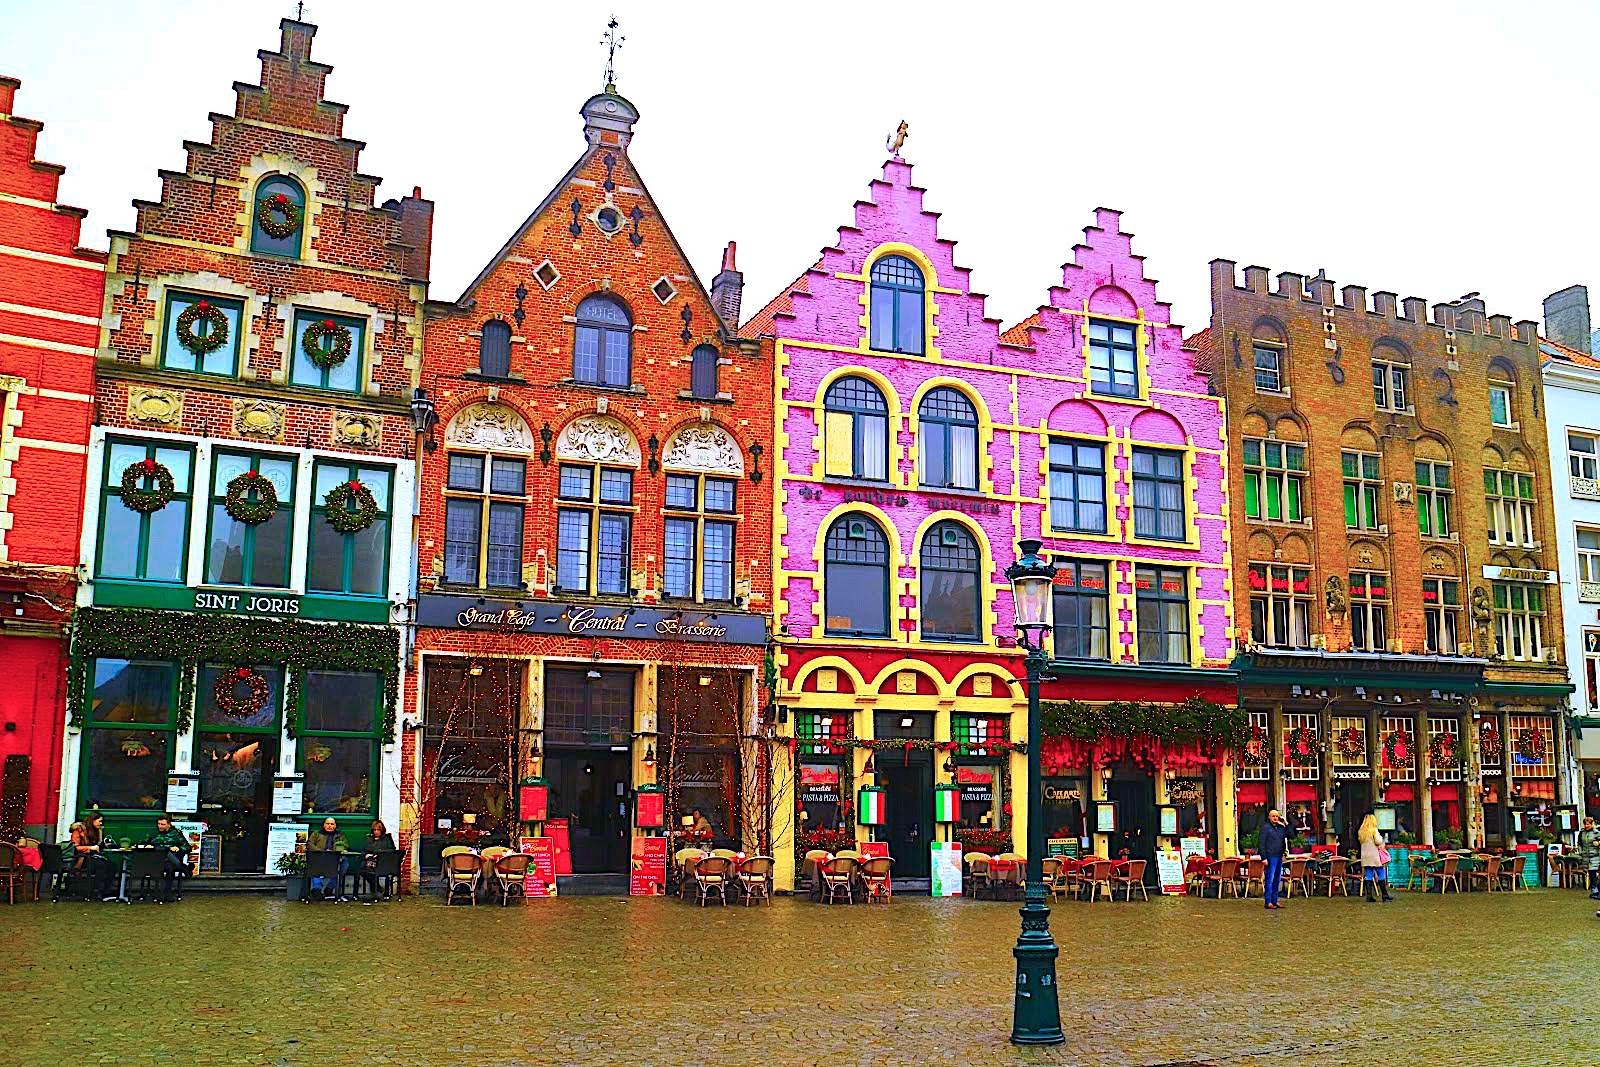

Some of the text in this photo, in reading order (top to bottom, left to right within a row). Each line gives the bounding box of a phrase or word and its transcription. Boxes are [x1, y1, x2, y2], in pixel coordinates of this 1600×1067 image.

[195, 593, 299, 614] SINT JORIS
[457, 607, 506, 627] Grand
[567, 606, 628, 633] Central
[655, 617, 726, 637] Brasserie
[1256, 657, 1353, 671] RESTAURANT
[440, 755, 497, 777] Central
[802, 794, 819, 802] PASTA
[823, 794, 840, 802] PIZZA
[961, 793, 975, 801] PASTA
